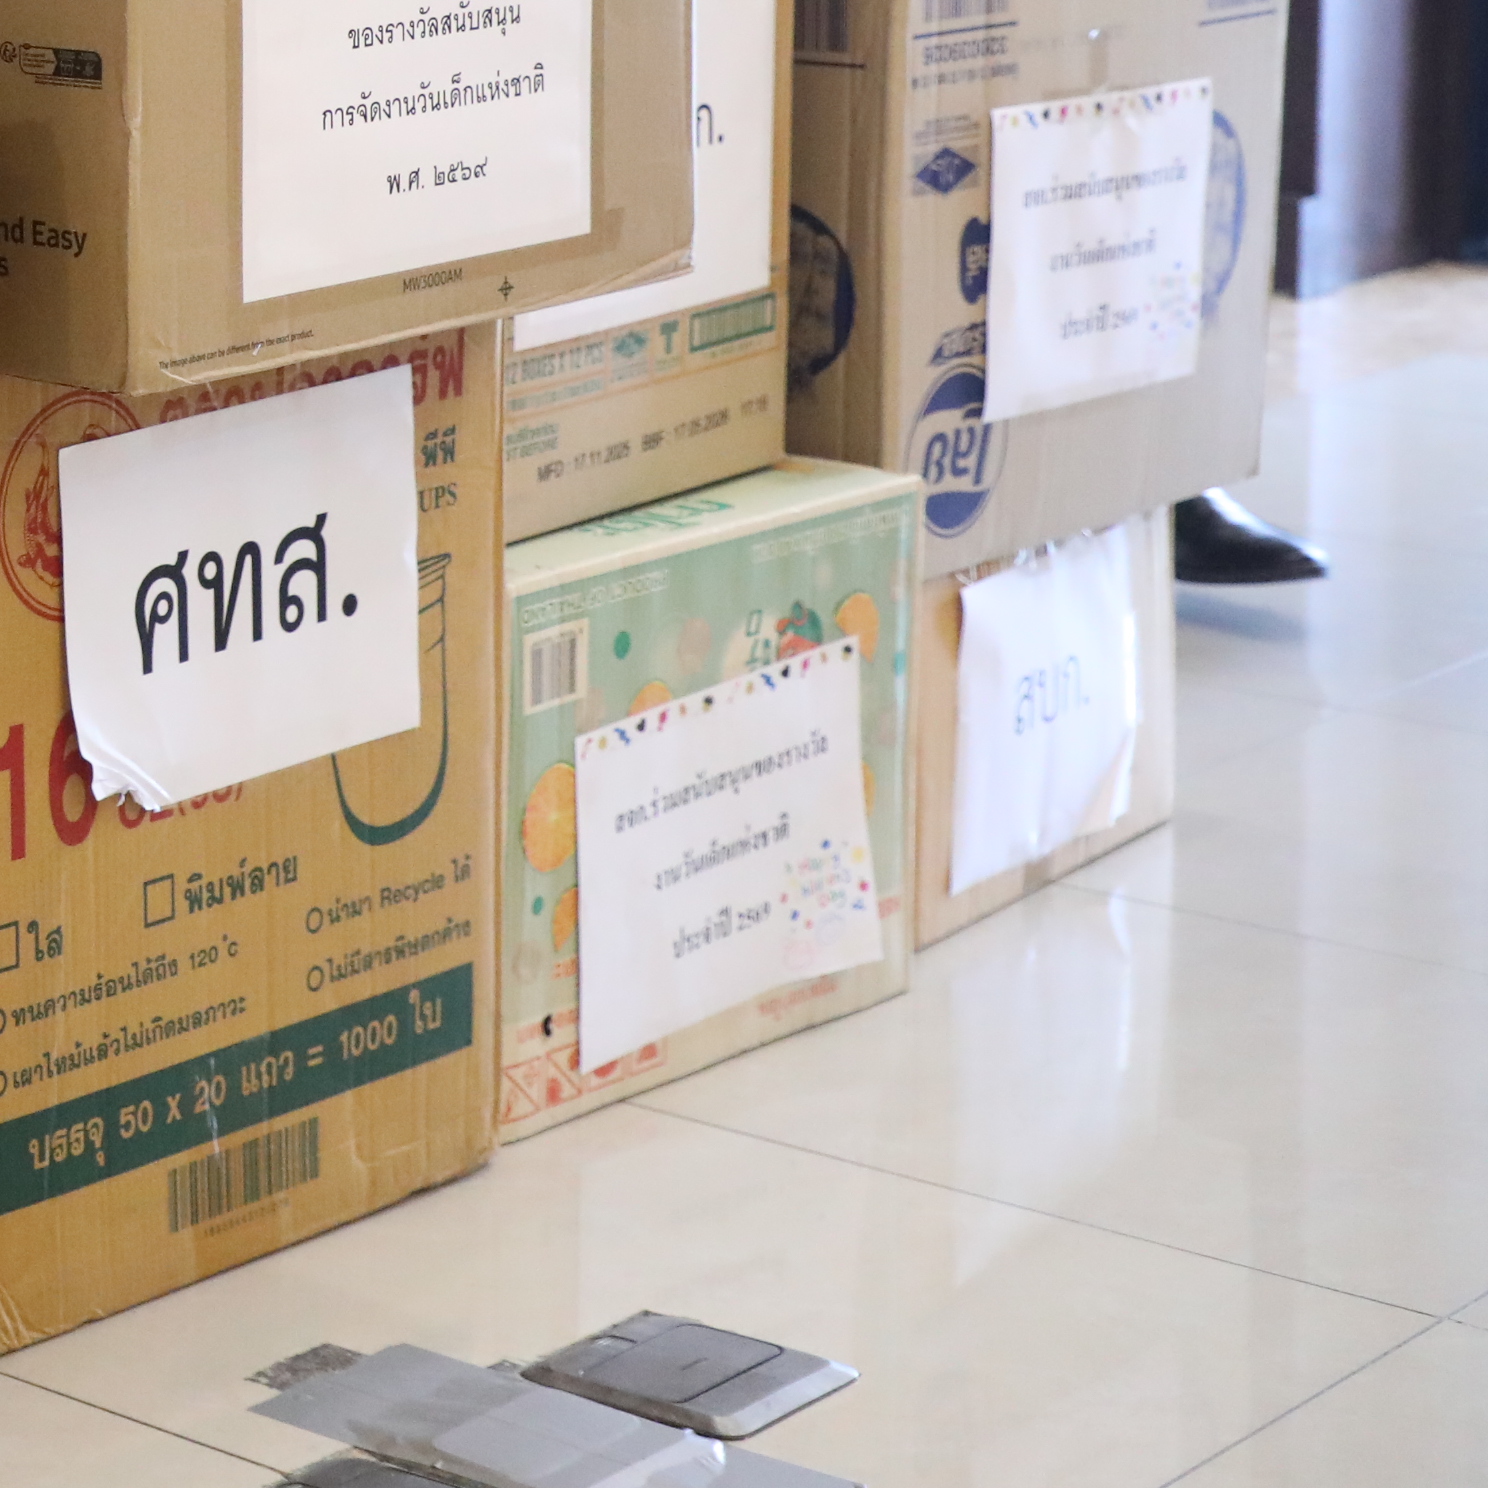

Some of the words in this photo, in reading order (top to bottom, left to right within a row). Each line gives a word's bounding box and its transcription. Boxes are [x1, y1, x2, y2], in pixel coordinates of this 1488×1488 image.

[347, 0, 522, 51] ของรางวัลสนับสนุน
[321, 63, 546, 131] การจัดงานวันเด็กแห่งชาติ
[386, 167, 426, 196] พ.ศ.
[432, 158, 489, 189] ๒๕๖๙
[31, 219, 87, 258] Easy
[169, 356, 188, 369] image
[188, 352, 206, 364] above
[206, 351, 217, 360] can
[218, 348, 226, 358] be
[226, 342, 252, 356] different
[265, 337, 275, 347] the
[275, 334, 290, 345] exact
[418, 482, 458, 513] UPS
[133, 512, 359, 675] ศทส.
[182, 854, 299, 913] พิมพ์ลาย
[379, 872, 446, 909] Recycle
[26, 920, 65, 962] ใส
[10, 953, 178, 1028] ทนความร้อนได้ถึง
[187, 945, 219, 971] 120
[28, 1115, 106, 1170] บรรจุ
[118, 1100, 155, 1141] 50
[240, 1048, 295, 1097] แถว
[339, 1012, 398, 1061] 1000
[408, 989, 443, 1032] ใบ
